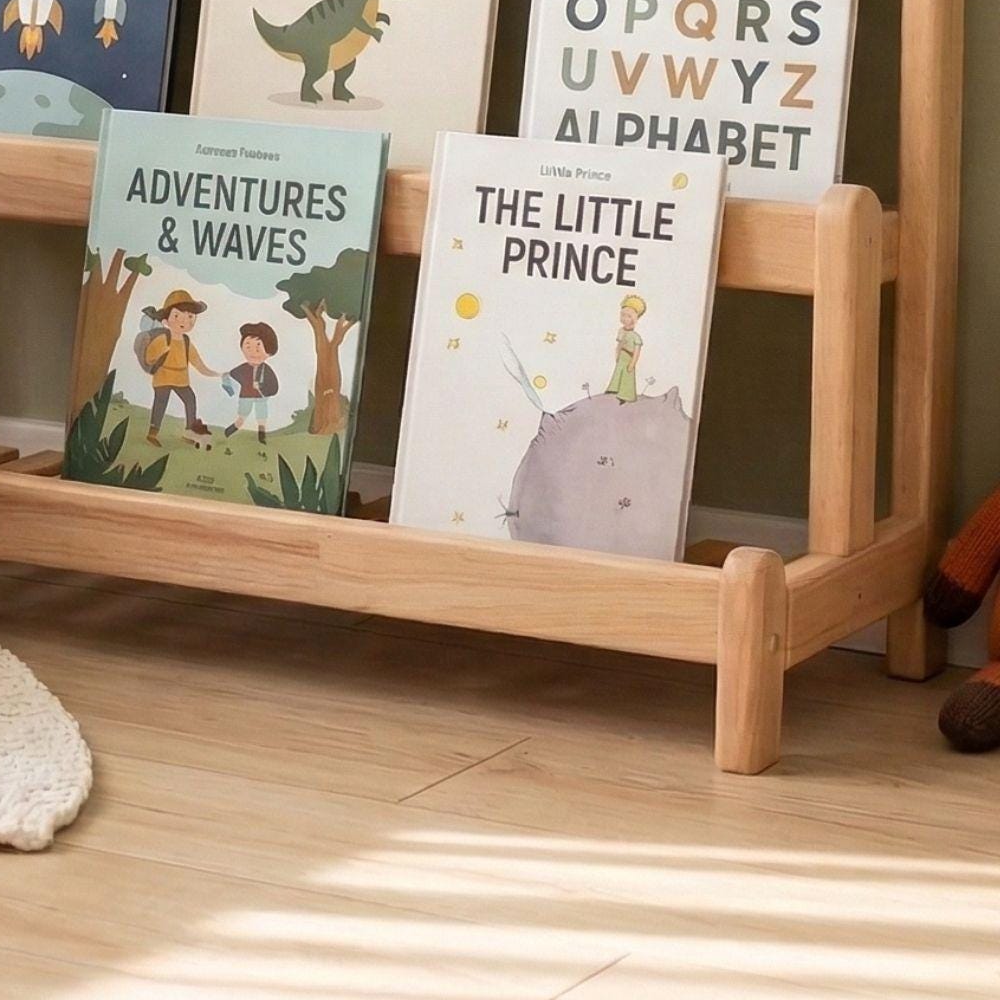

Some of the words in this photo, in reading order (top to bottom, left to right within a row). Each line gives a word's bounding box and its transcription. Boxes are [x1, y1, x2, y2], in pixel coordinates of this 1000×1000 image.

[787, 0, 823, 46] S
[561, 47, 598, 92] U
[611, 51, 651, 96] V
[662, 54, 719, 101] W
[731, 59, 770, 105] Y
[780, 63, 818, 109] Z
[126, 167, 348, 223] ADVENTURES
[575, 167, 612, 182] Prince
[475, 185, 544, 229] THE
[554, 193, 676, 242] LITTLE
[157, 216, 179, 254] &
[192, 219, 308, 266] WAVES
[501, 237, 640, 287] PRINCE
